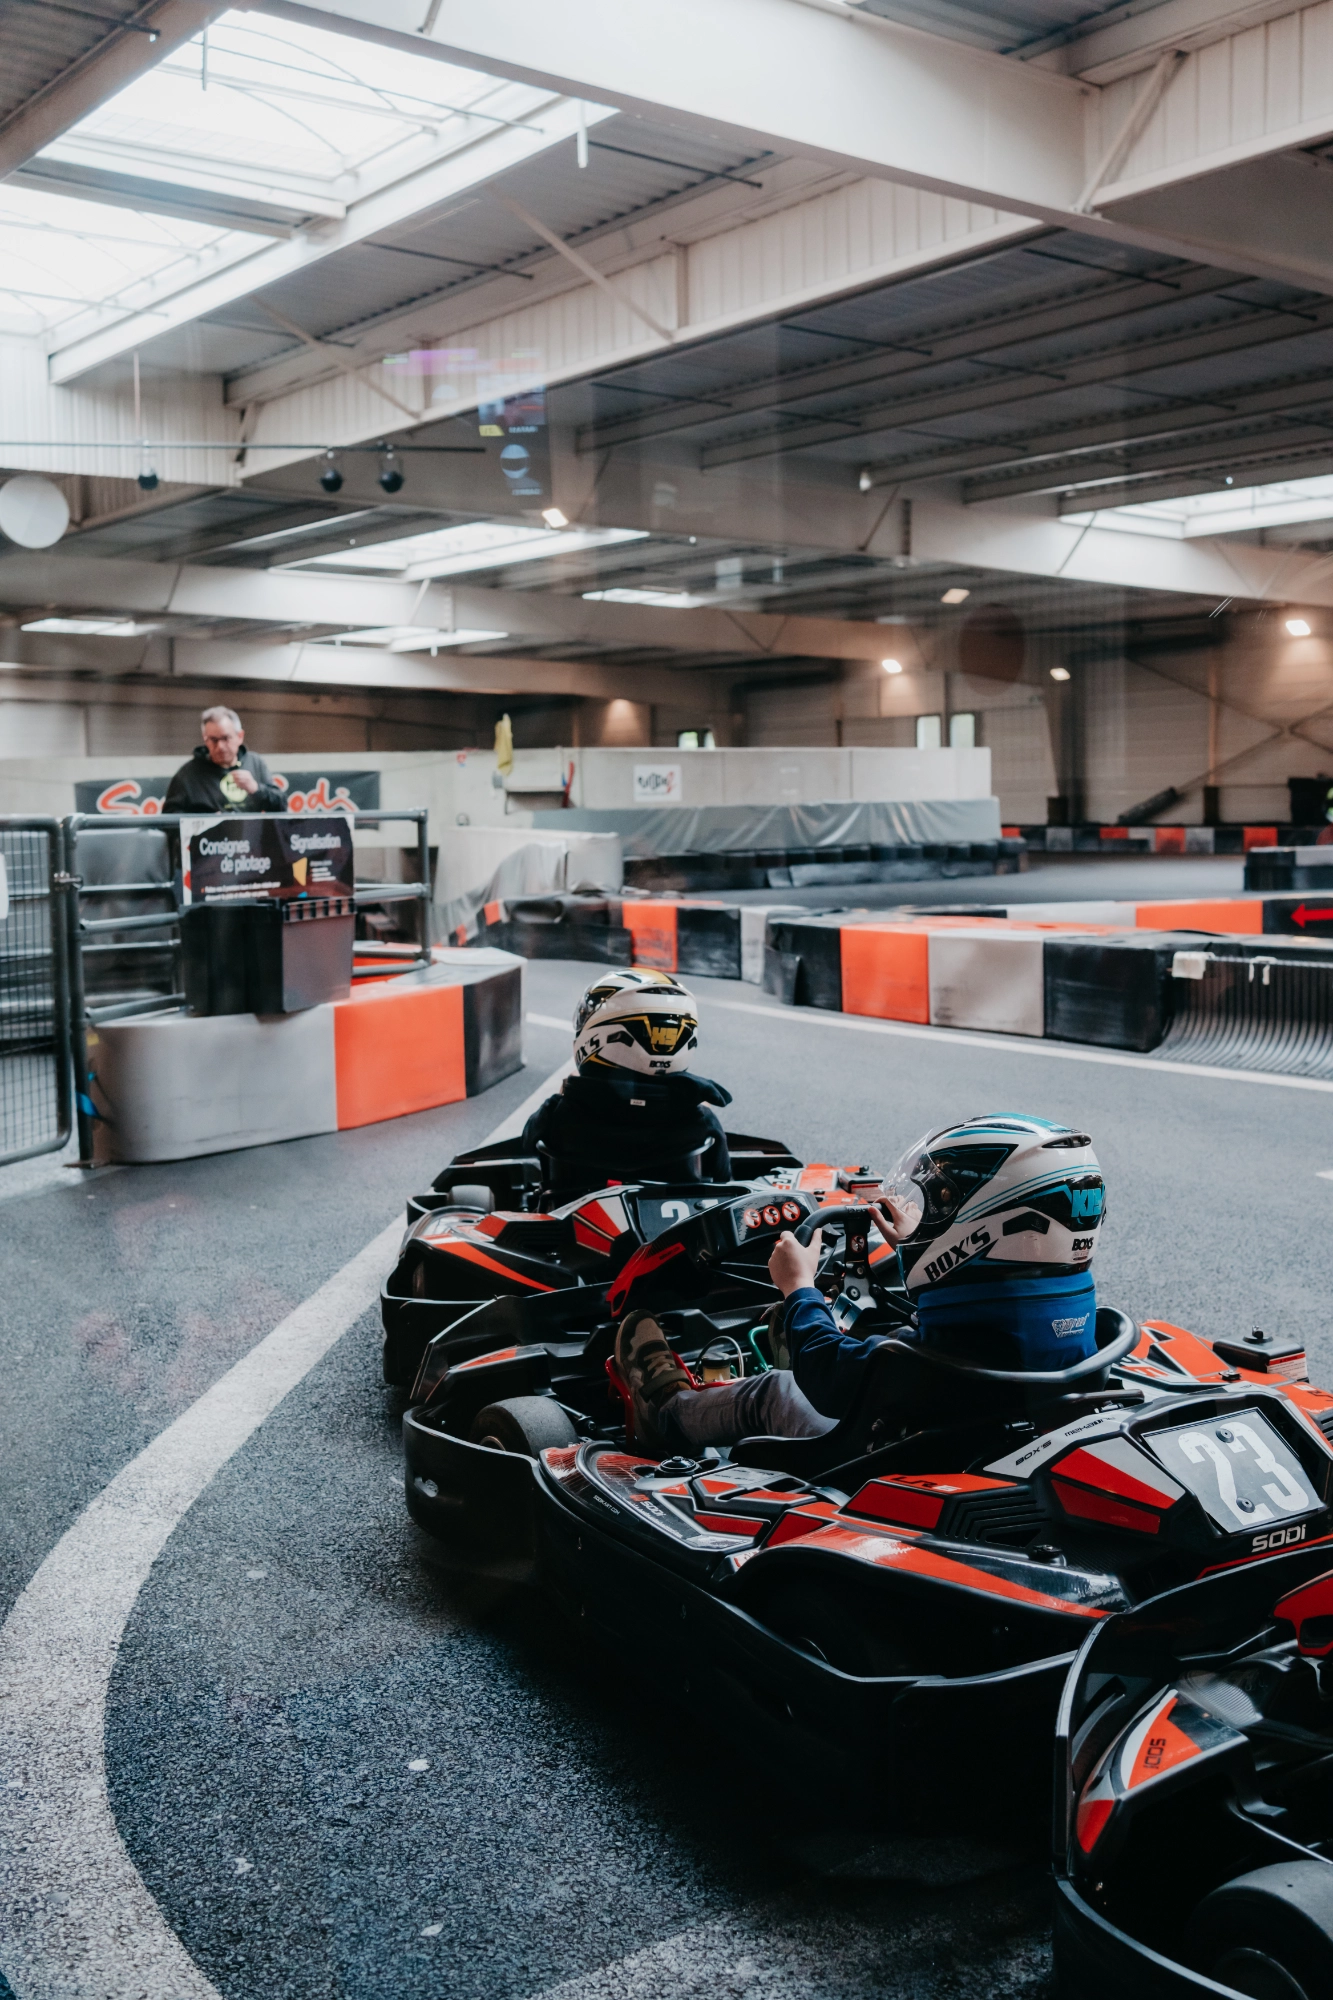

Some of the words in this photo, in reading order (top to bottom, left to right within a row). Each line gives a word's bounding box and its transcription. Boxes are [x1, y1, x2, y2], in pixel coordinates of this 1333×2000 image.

[199, 837, 250, 857] Consignes
[290, 833, 341, 853] Signalisation
[220, 857, 234, 873] de
[234, 855, 271, 875] pilotage
[924, 1225, 991, 1283] BOX'S
[1015, 1440, 1052, 1466] BOX'S
[1178, 1421, 1310, 1526] 23
